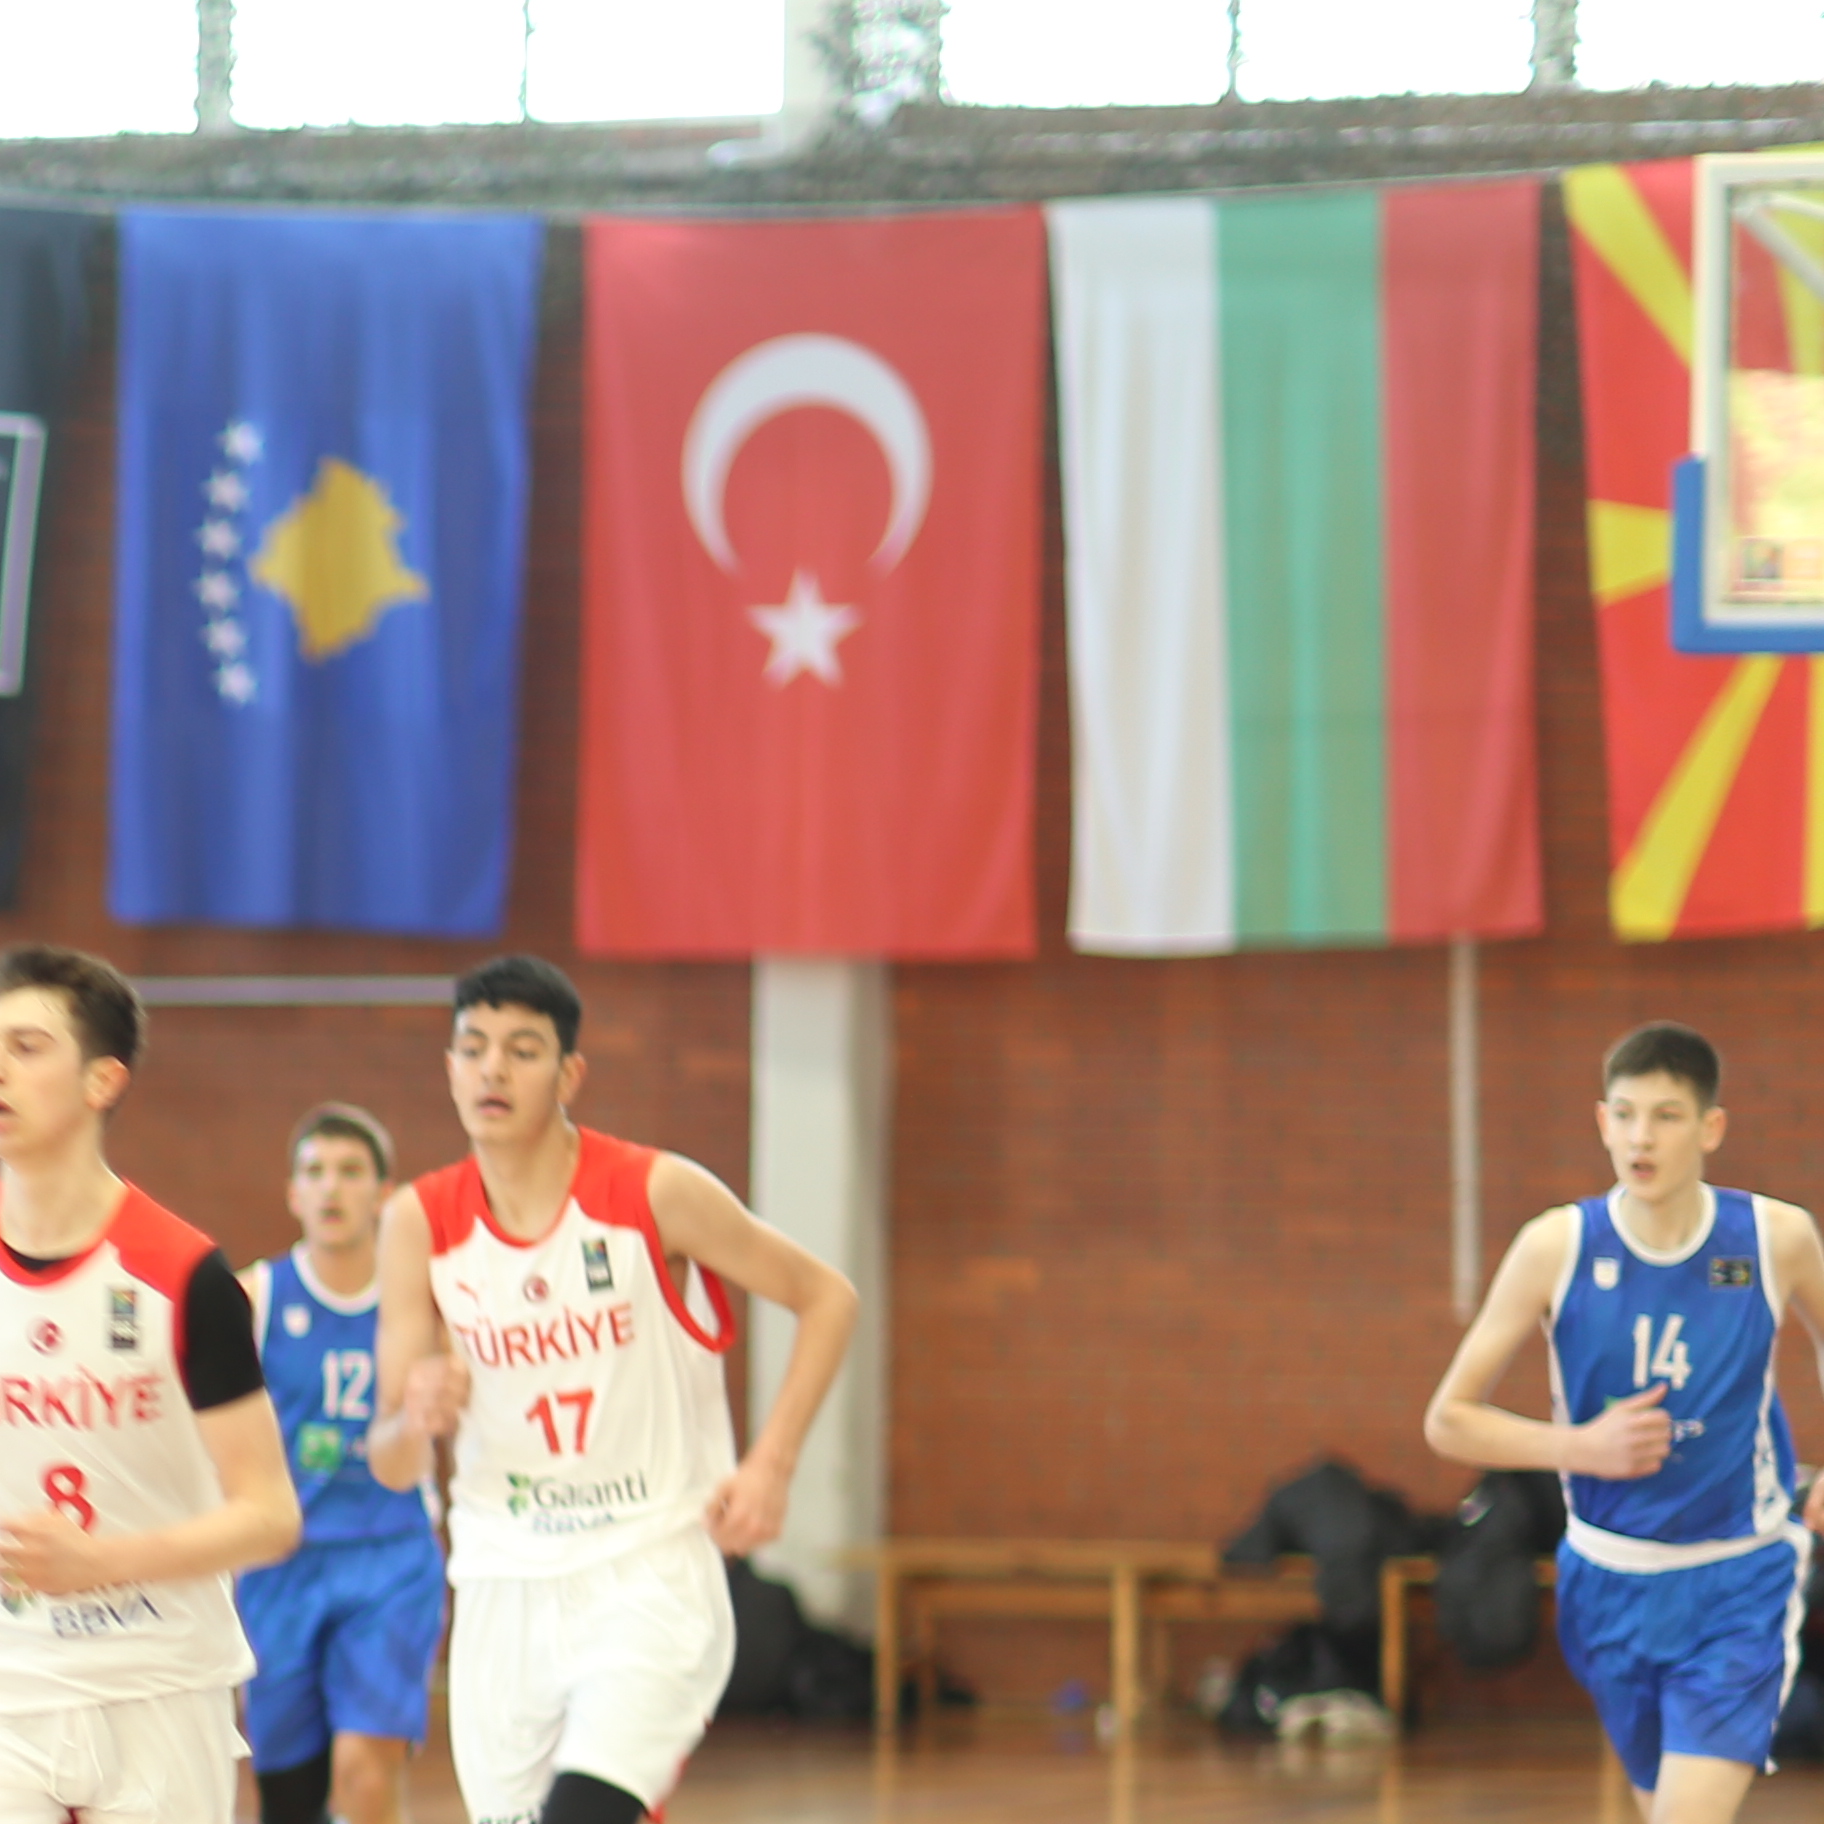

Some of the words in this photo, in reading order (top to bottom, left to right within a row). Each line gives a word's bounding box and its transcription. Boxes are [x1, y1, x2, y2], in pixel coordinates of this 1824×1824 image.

[454, 1300, 636, 1371] TÜRKİYE
[1632, 1313, 1692, 1391] 14
[324, 1349, 372, 1420] 12
[525, 1388, 597, 1457] 17
